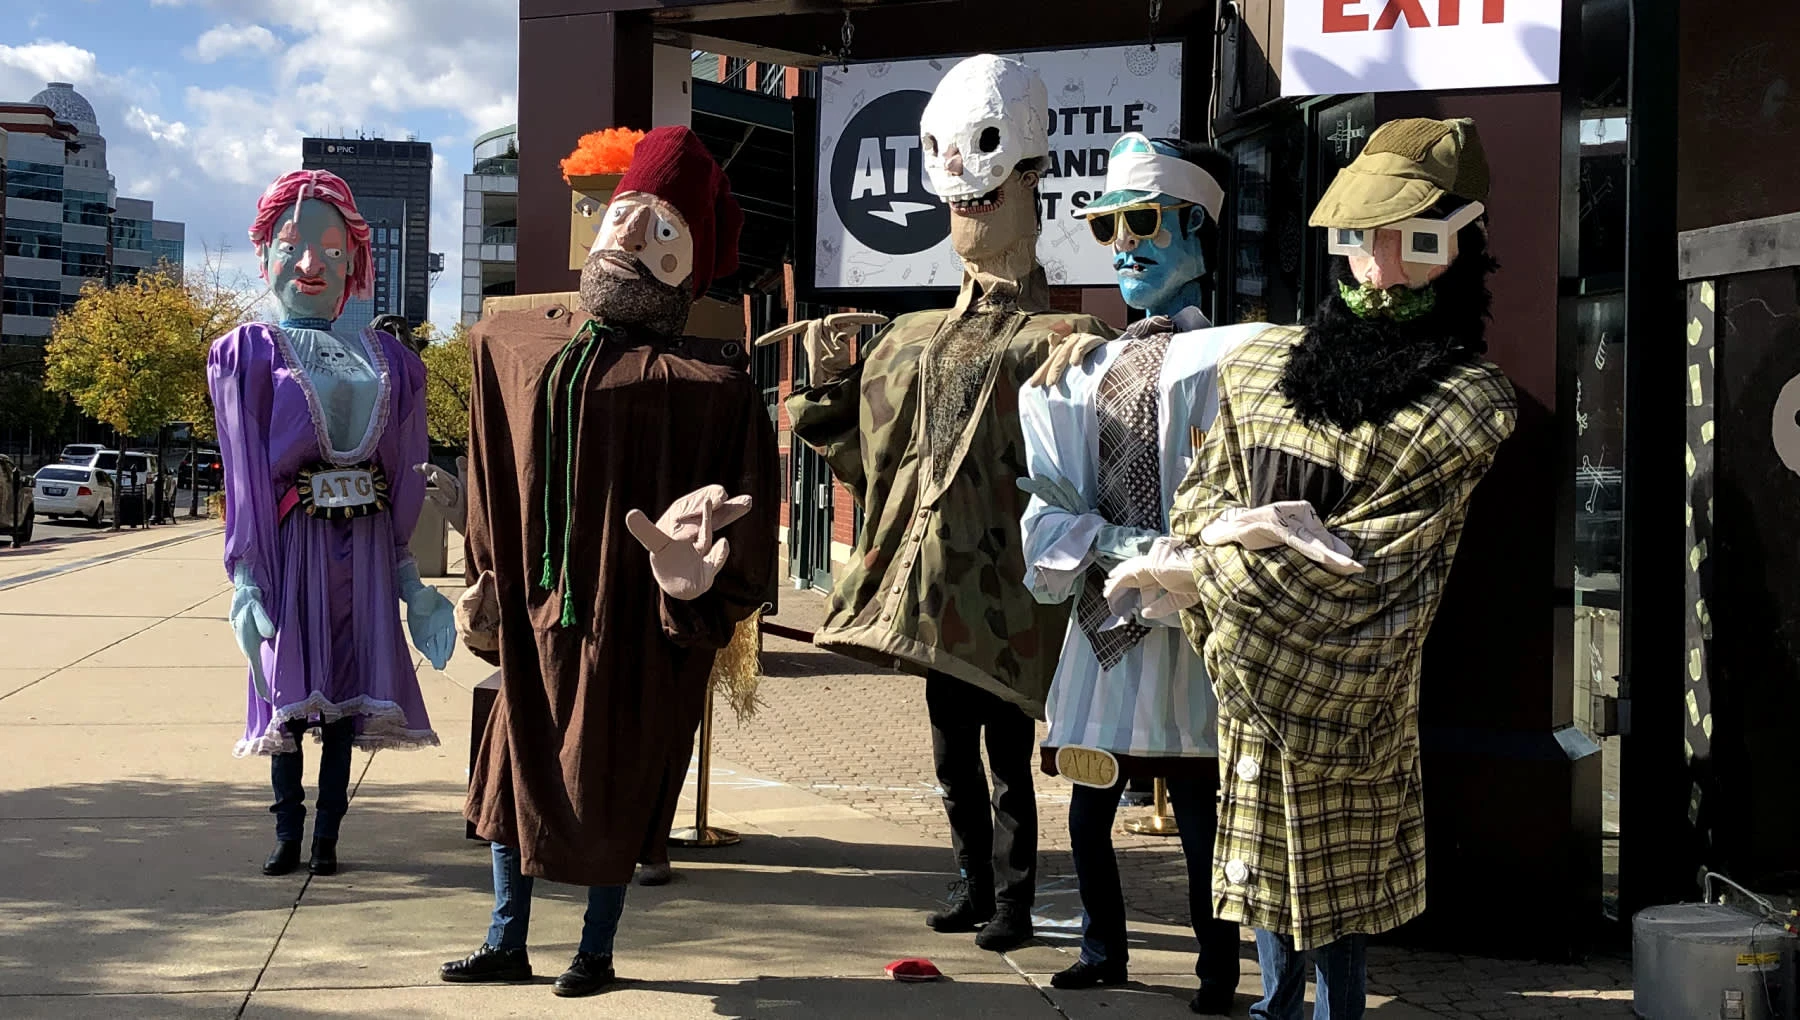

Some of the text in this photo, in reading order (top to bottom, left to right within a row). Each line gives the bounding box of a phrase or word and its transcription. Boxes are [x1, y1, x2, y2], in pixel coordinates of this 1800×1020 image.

[336, 145, 354, 154] PNC
[851, 135, 937, 200] AT
[319, 476, 371, 498] ATG
